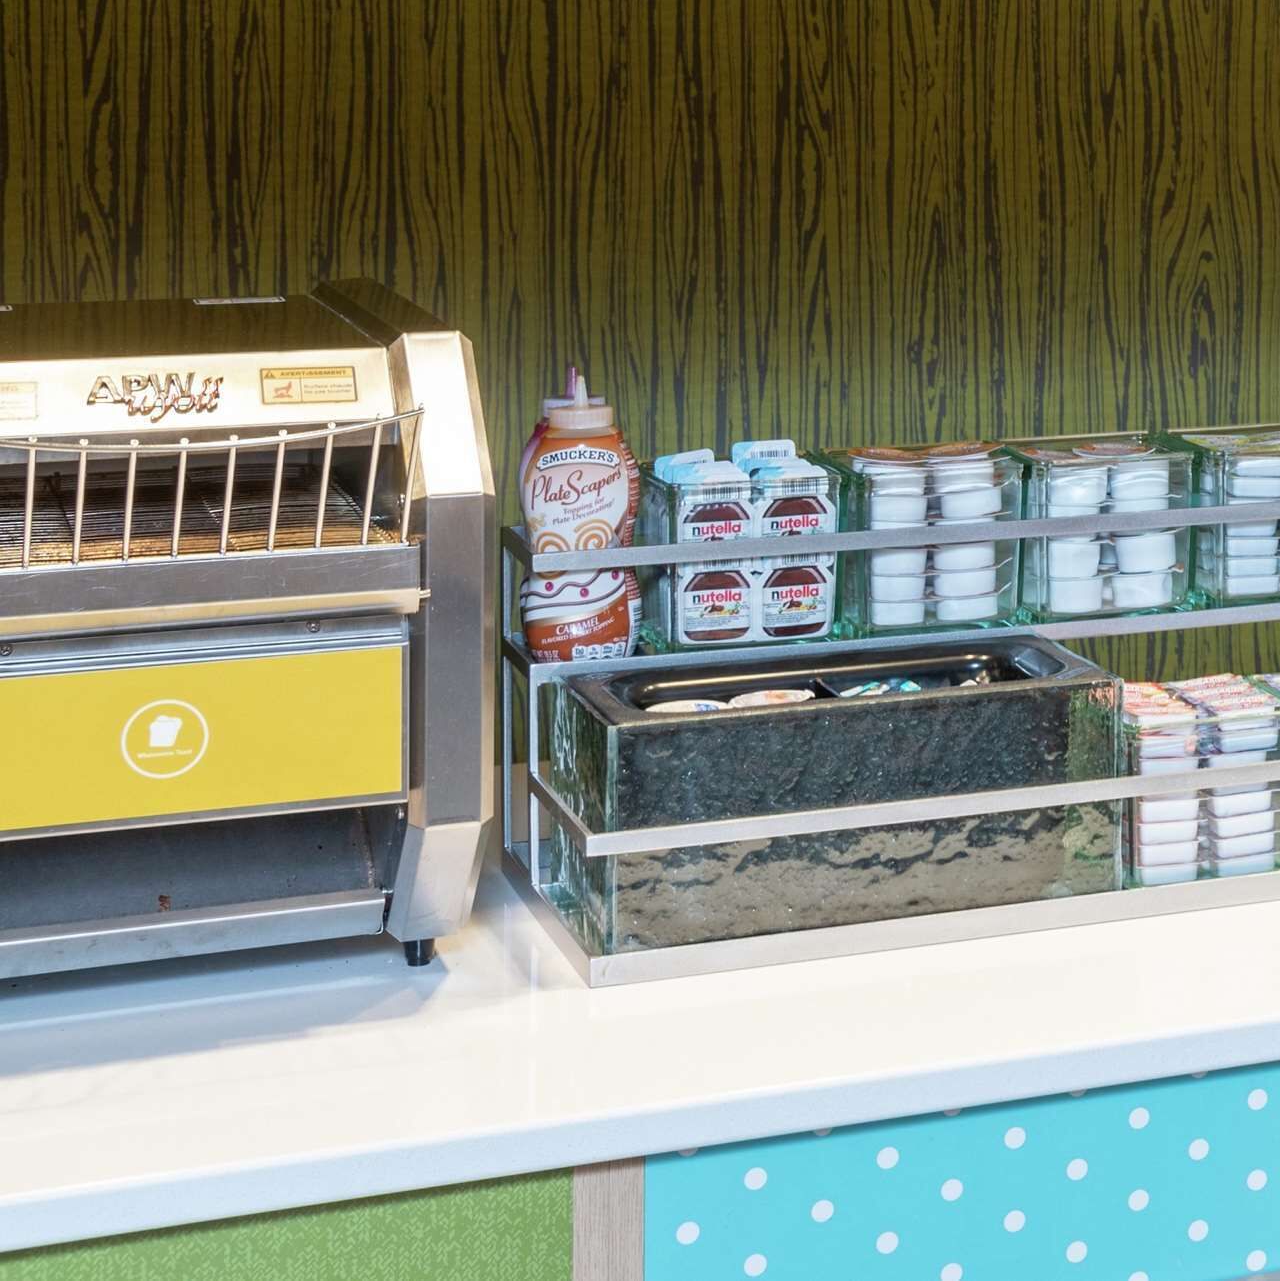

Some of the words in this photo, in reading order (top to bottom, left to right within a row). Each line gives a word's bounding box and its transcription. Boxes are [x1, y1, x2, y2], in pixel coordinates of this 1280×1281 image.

[87, 372, 196, 405] APW
[541, 450, 615, 466] SMUCKER'S
[692, 522, 741, 536] nutella
[771, 515, 819, 529] nutella
[693, 591, 742, 604] nutella
[772, 584, 819, 599] nutella
